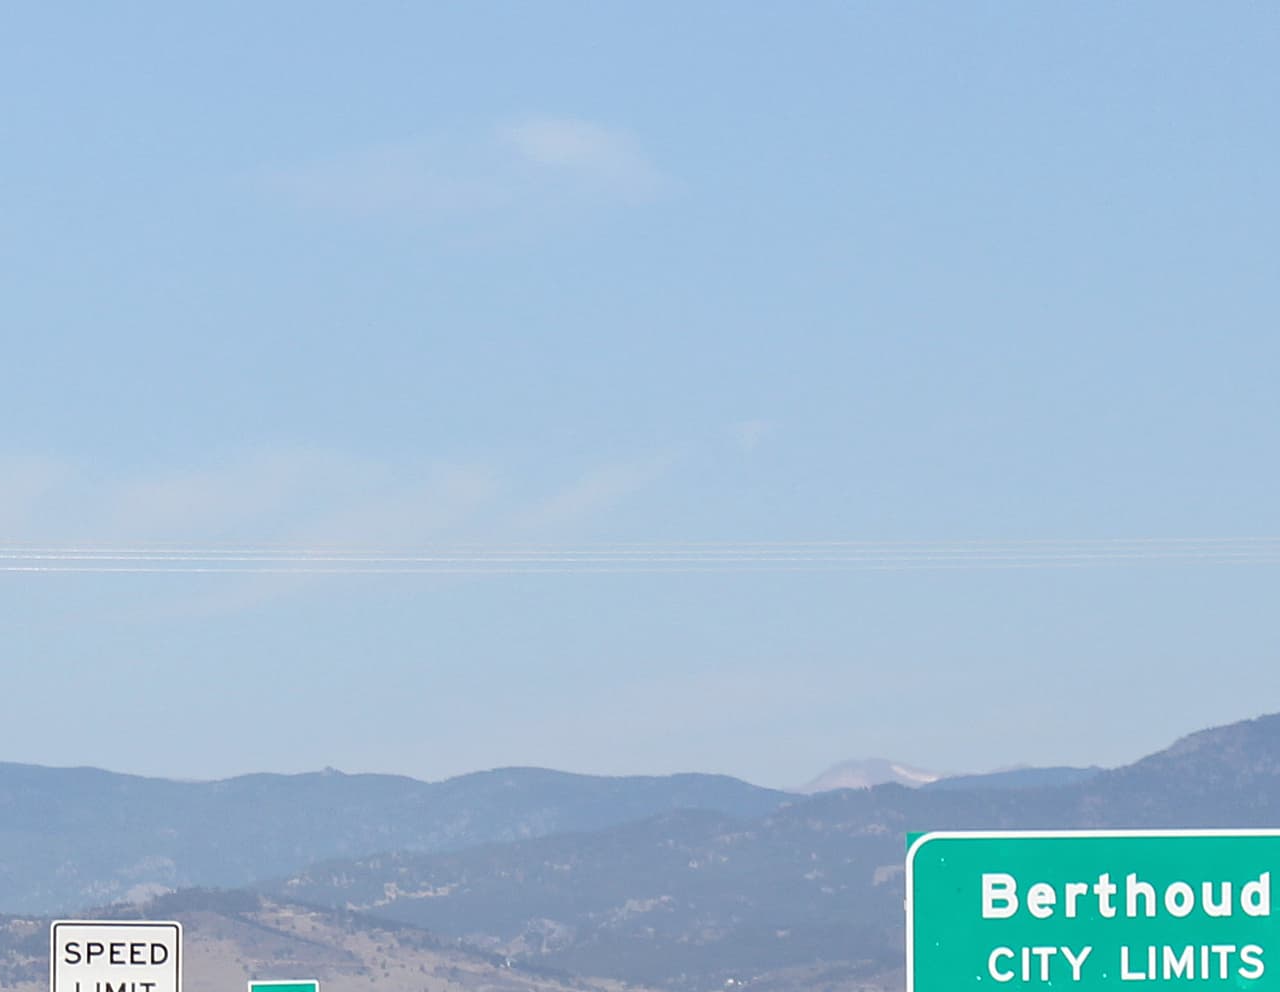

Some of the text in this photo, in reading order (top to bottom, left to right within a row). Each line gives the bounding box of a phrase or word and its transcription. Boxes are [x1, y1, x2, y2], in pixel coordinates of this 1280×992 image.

[981, 871, 1270, 919] Berthoud
[64, 942, 168, 965] SPEED
[988, 945, 1265, 981] CITY LIMITS
